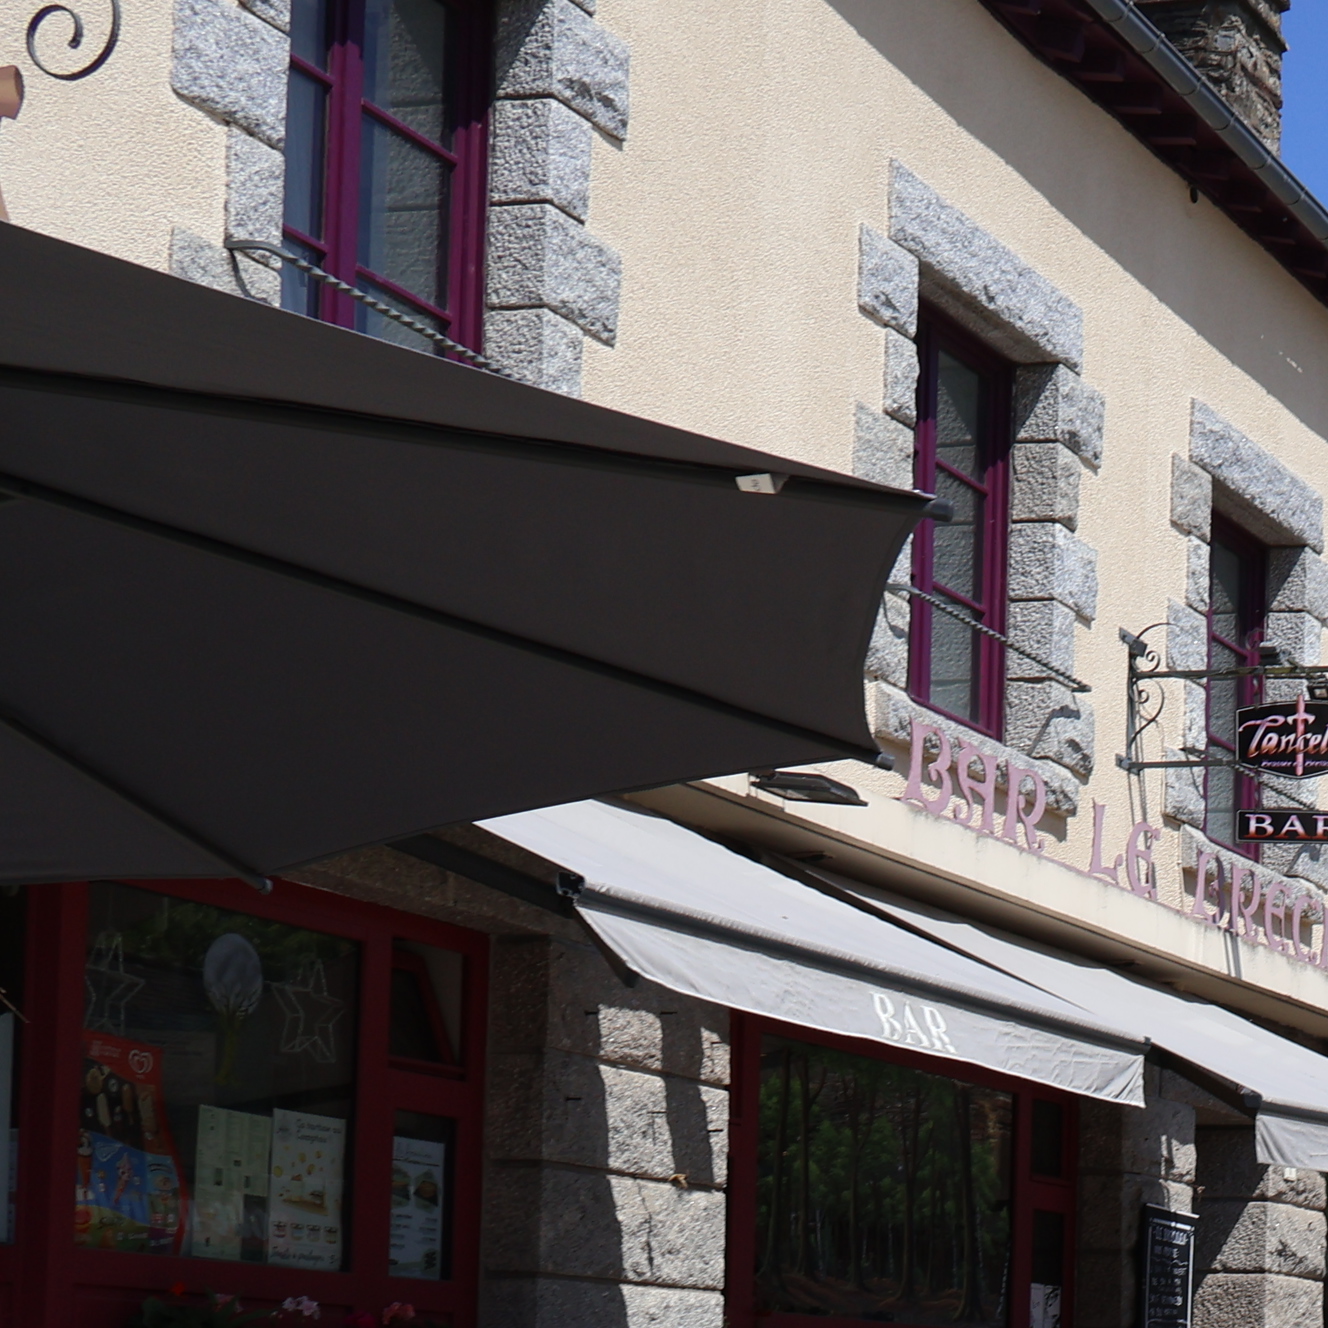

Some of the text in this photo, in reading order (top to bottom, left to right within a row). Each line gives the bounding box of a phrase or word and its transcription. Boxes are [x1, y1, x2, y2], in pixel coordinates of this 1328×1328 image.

[904, 717, 1045, 852] BAR
[1088, 797, 1161, 900] LE
[869, 991, 958, 1054] BAR
